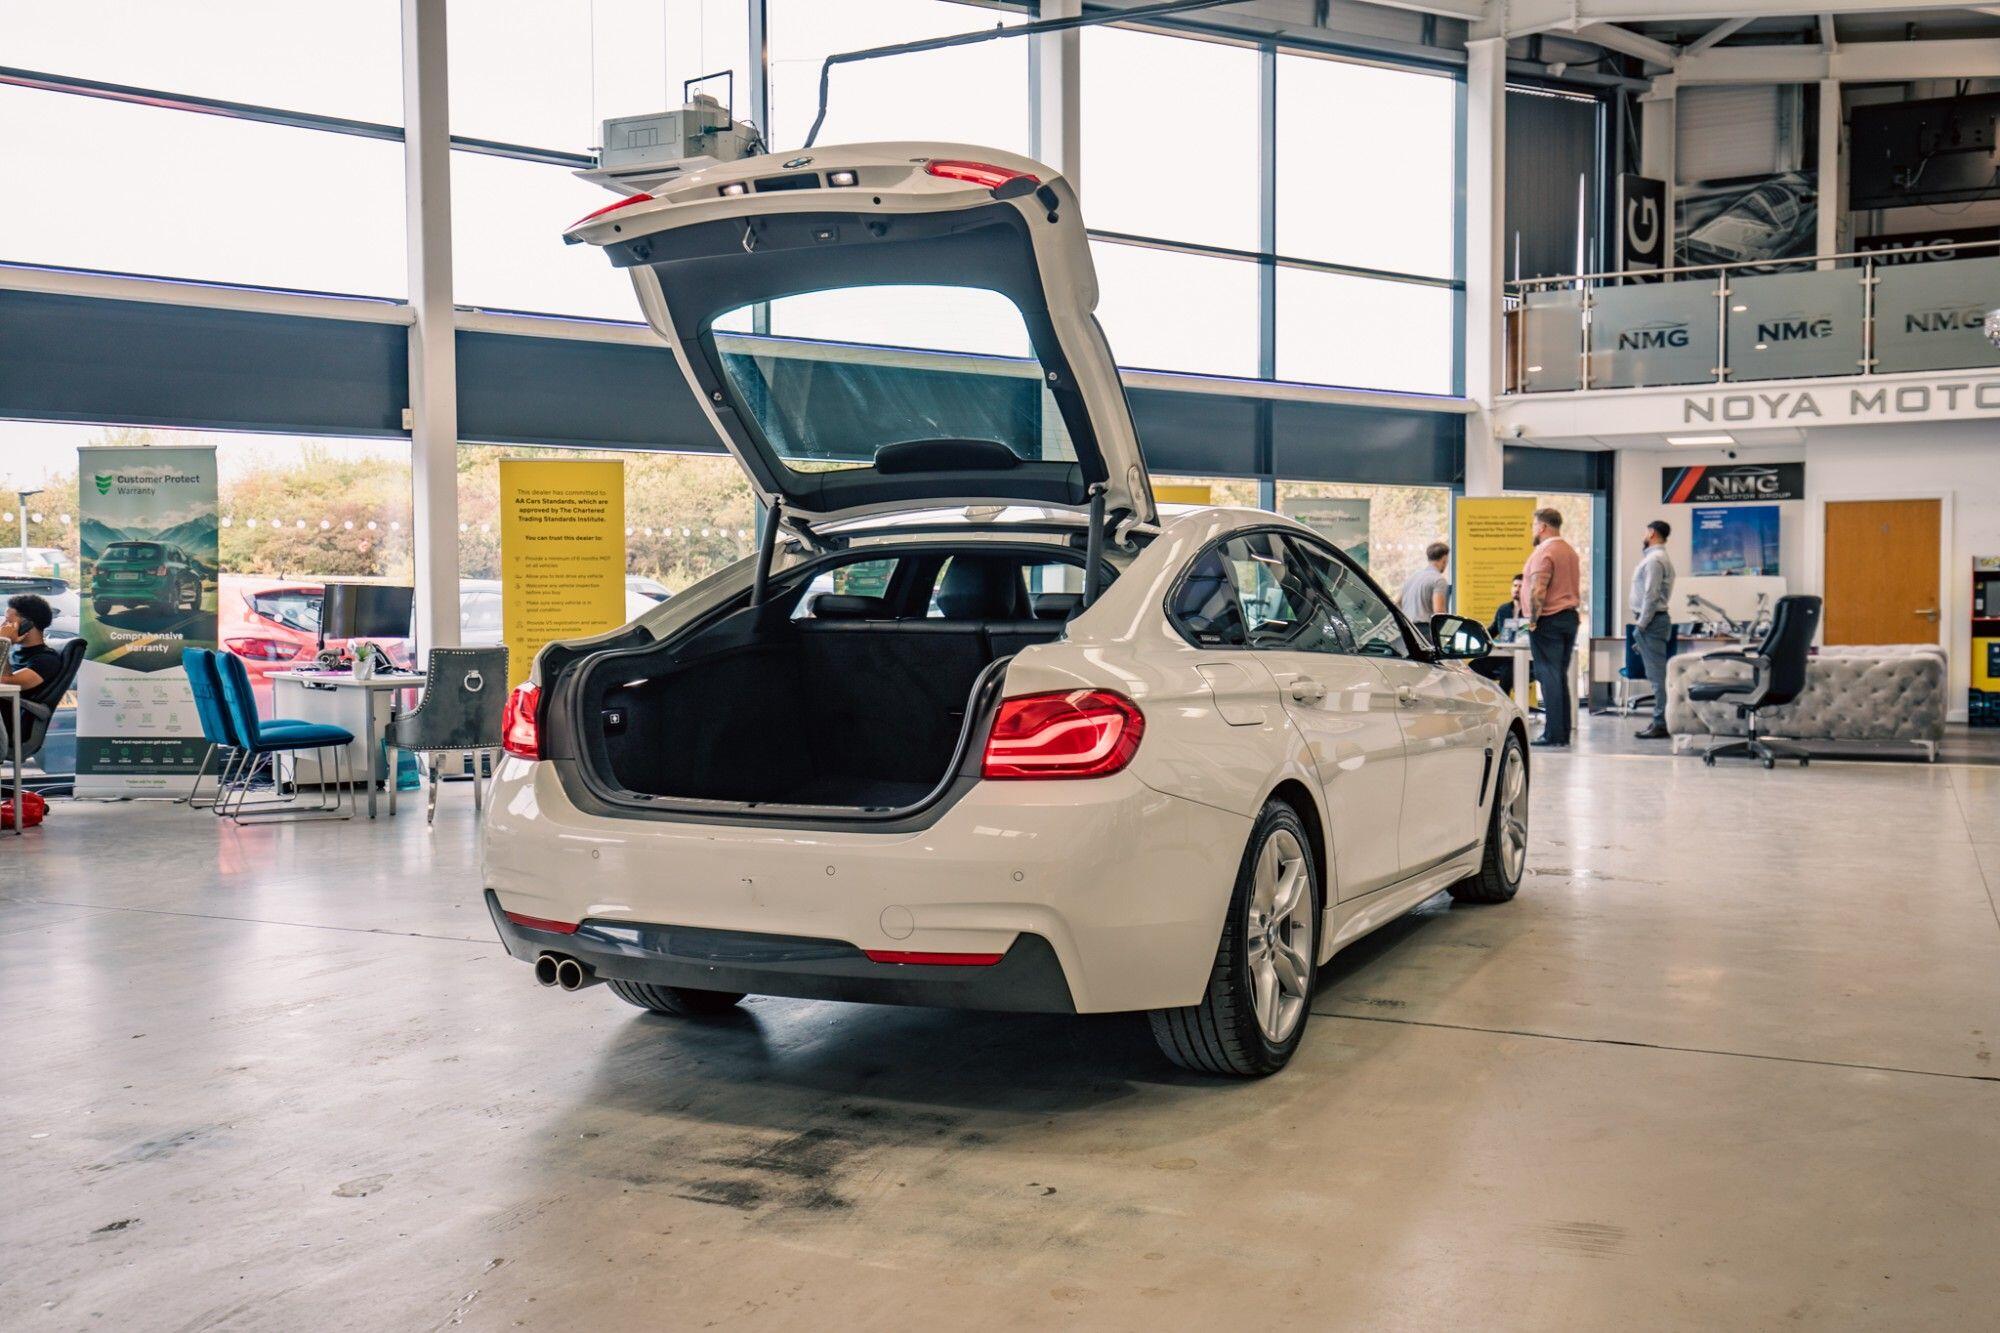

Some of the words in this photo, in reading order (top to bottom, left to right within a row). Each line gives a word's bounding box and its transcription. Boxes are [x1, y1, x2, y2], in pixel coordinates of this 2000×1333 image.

[1860, 238, 1956, 267] NMG
[1757, 319, 1832, 342] NMG
[1905, 309, 1986, 333] NMG
[1619, 328, 1689, 350] NMG
[1683, 392, 1823, 424] NOYA
[1851, 383, 2000, 415] MOTO
[116, 473, 162, 485] Customer
[164, 473, 200, 485] Protect
[1707, 474, 1779, 495] NMG
[117, 486, 156, 497] Warranty
[110, 630, 184, 643] Comprehensive
[126, 642, 169, 655] Warranty
